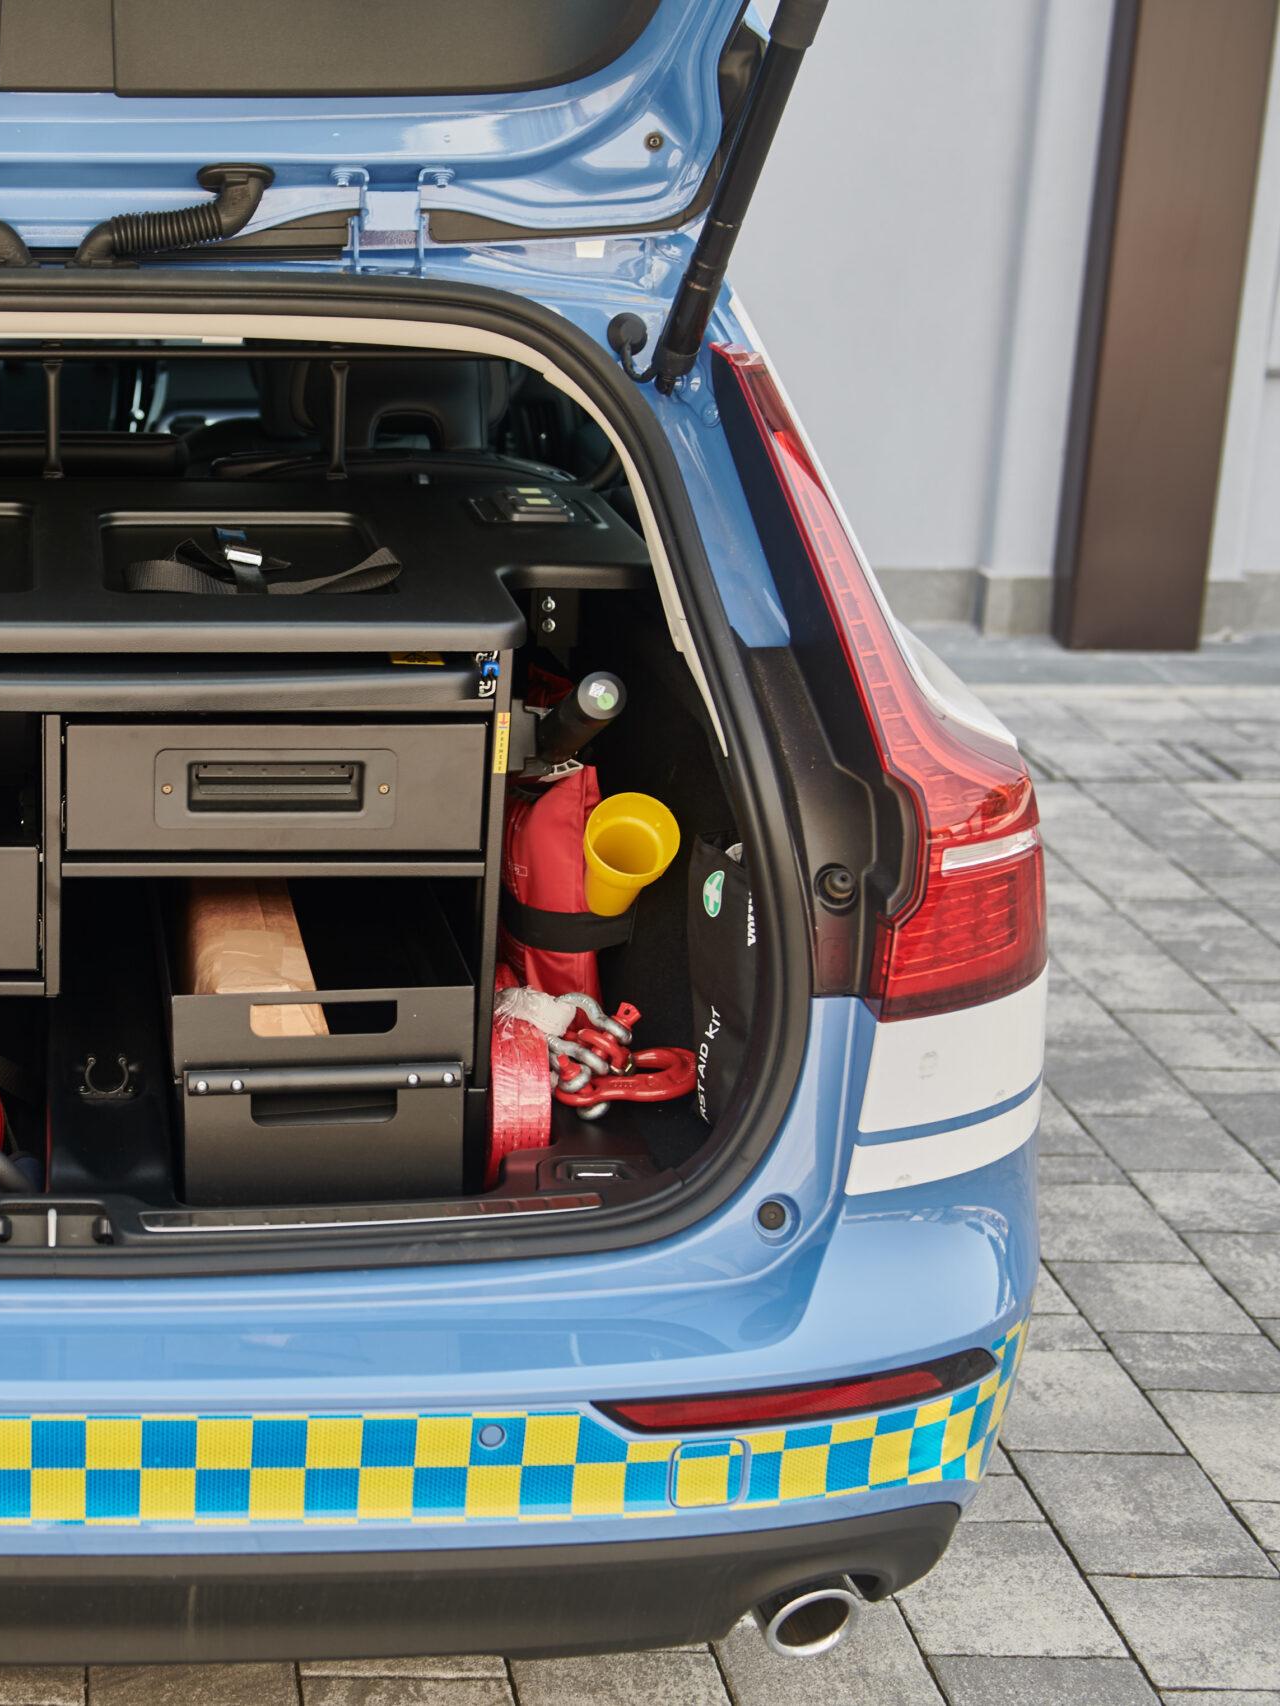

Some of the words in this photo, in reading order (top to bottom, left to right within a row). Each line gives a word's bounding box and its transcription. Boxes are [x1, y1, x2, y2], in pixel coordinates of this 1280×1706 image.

[704, 1005, 721, 1040] KIT
[698, 1042, 709, 1079] AID
[697, 1079, 711, 1124] RST
